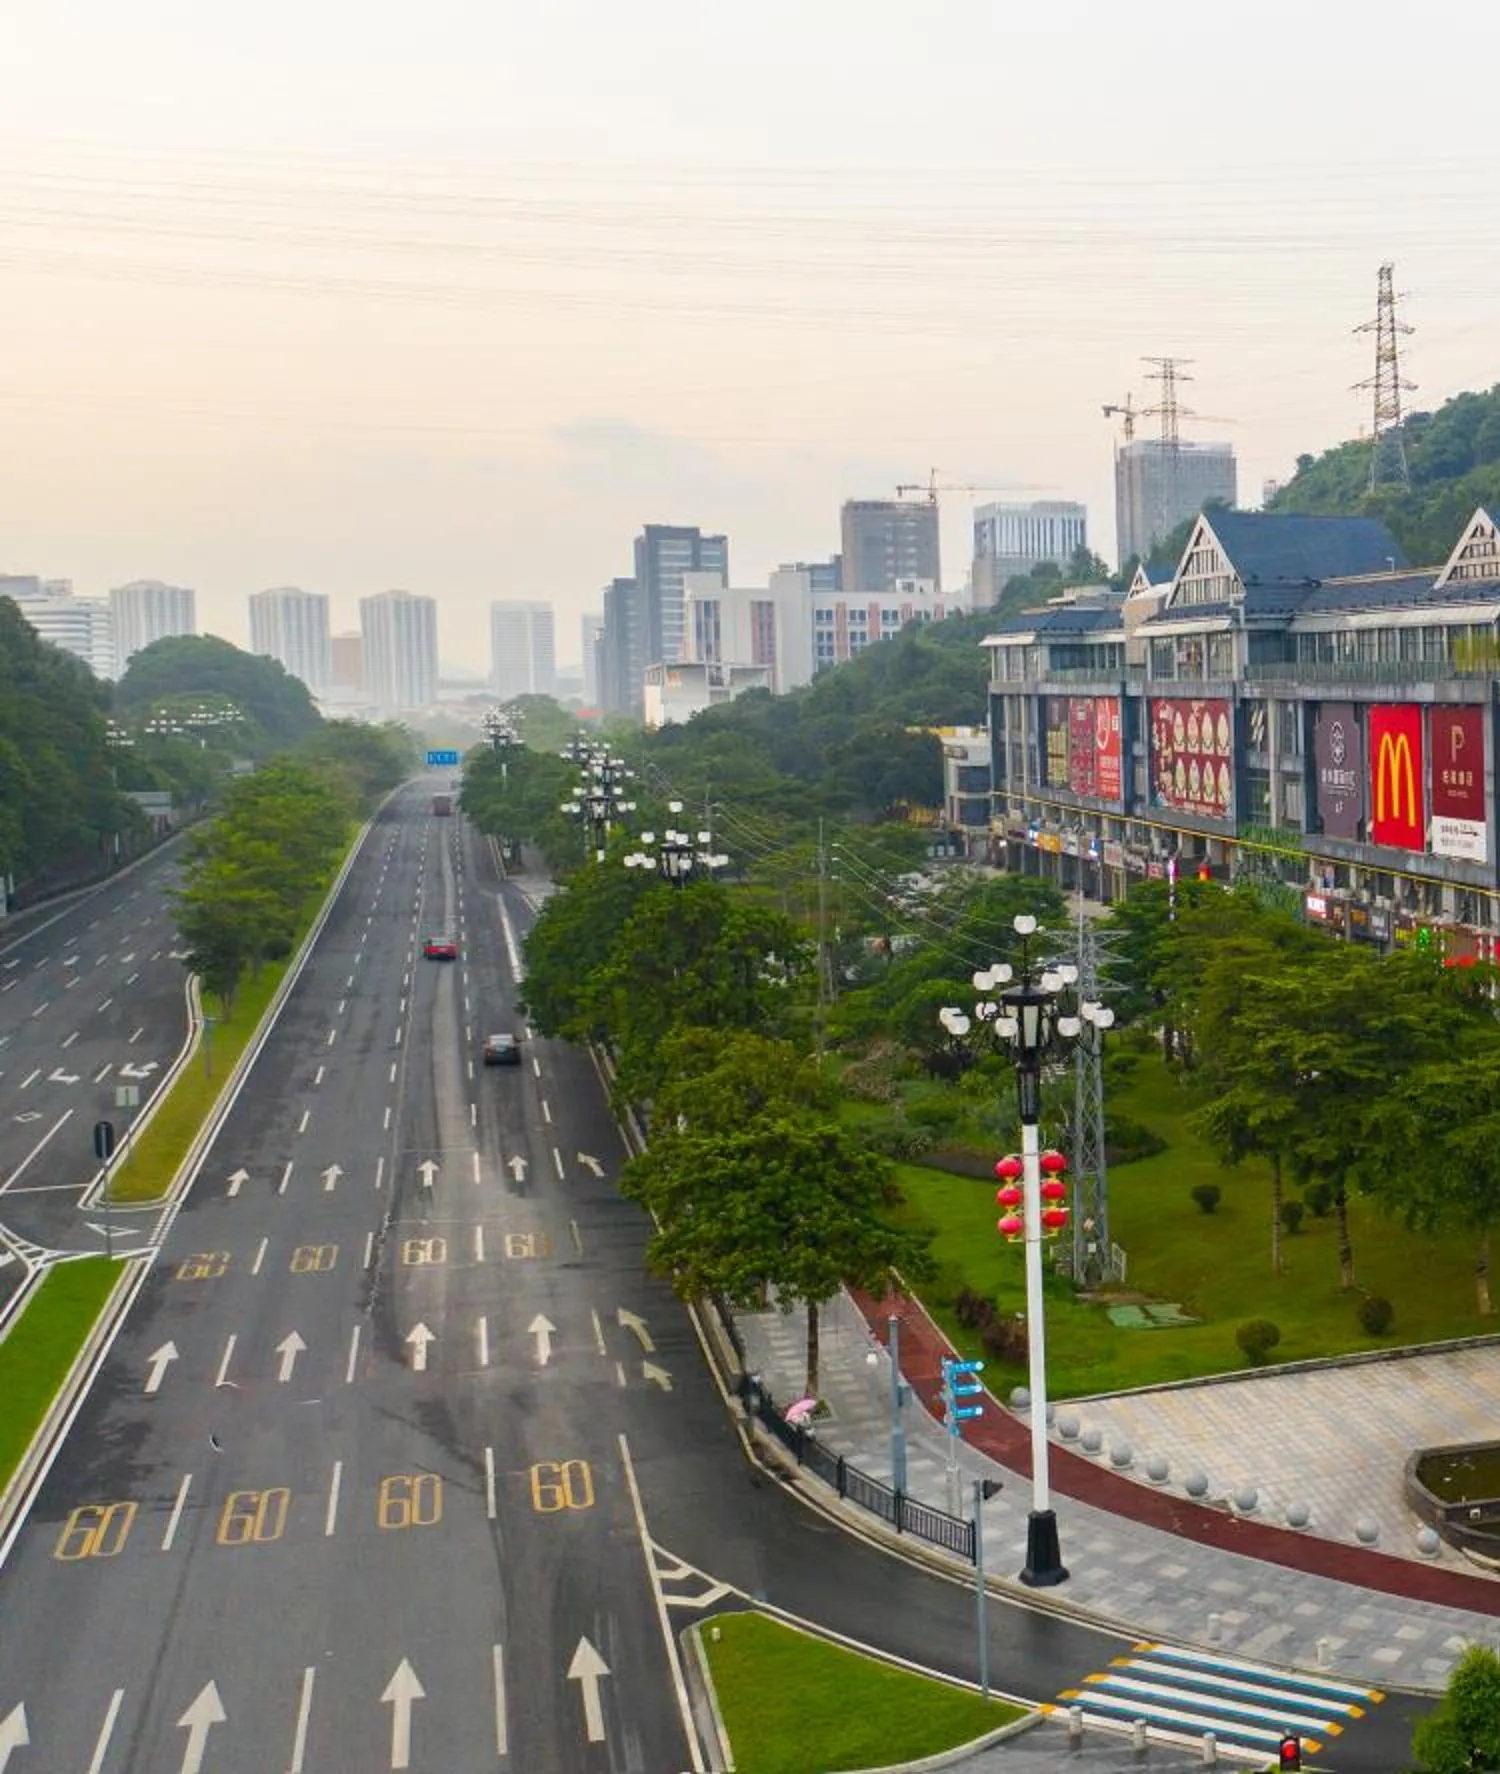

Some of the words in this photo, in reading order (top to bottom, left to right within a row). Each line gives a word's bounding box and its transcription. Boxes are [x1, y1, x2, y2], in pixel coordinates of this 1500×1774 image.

[1450, 725, 1465, 763] P
[290, 1244, 338, 1273] 60
[401, 1238, 448, 1266] 60
[504, 1233, 552, 1260] 60
[378, 1473, 443, 1530] 60
[530, 1459, 594, 1514] 60
[53, 1501, 138, 1562] 60
[216, 1487, 291, 1546] 60
